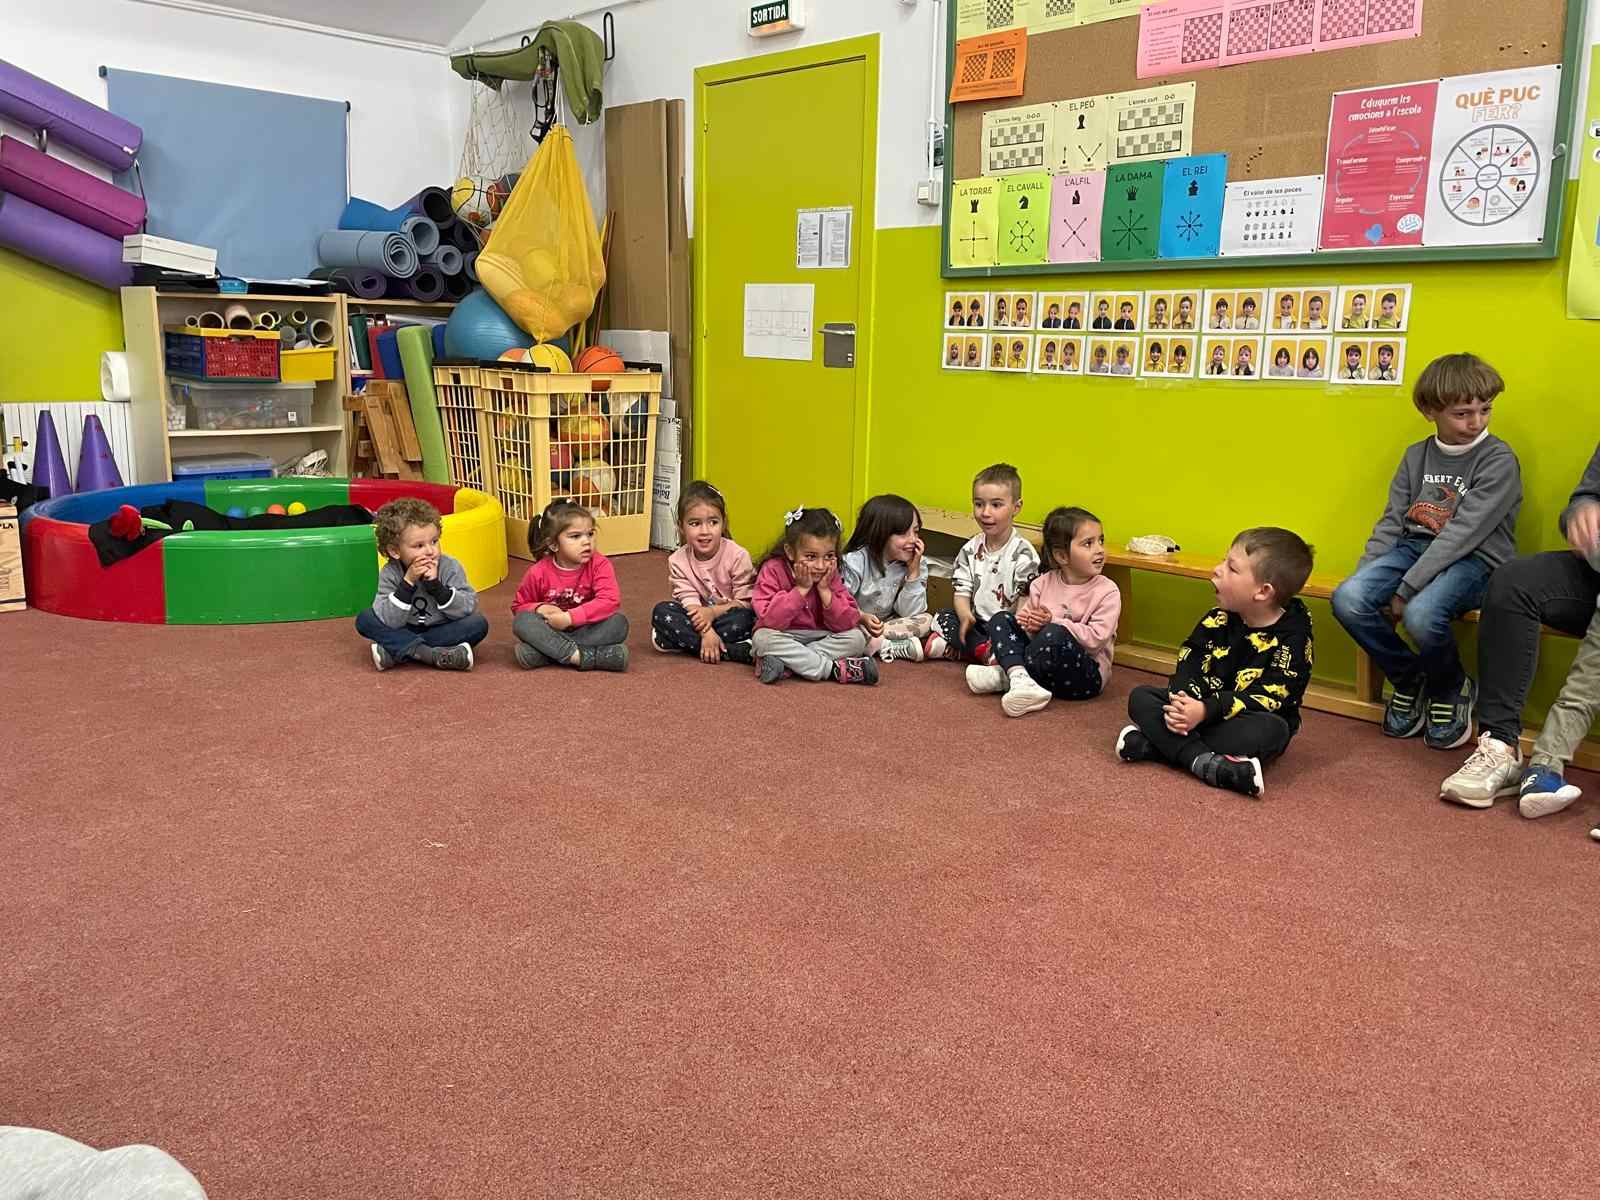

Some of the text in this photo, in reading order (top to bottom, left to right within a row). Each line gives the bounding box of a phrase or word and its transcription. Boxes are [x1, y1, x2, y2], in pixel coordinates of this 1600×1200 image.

[752, 4, 787, 24] SORTIDA
[1400, 94, 1412, 104] les
[1455, 85, 1541, 109] QUÈ PUC
[1069, 99, 1095, 111] EL PEÓ
[1386, 109, 1392, 117] a
[1471, 103, 1521, 123] FER?
[1115, 171, 1153, 183] LA DAMA
[1182, 165, 1209, 177] EL REI
[1007, 181, 1045, 193] EL CAVALL
[1064, 176, 1092, 187] L'ALFIL
[960, 186, 994, 197] LA TORRE
